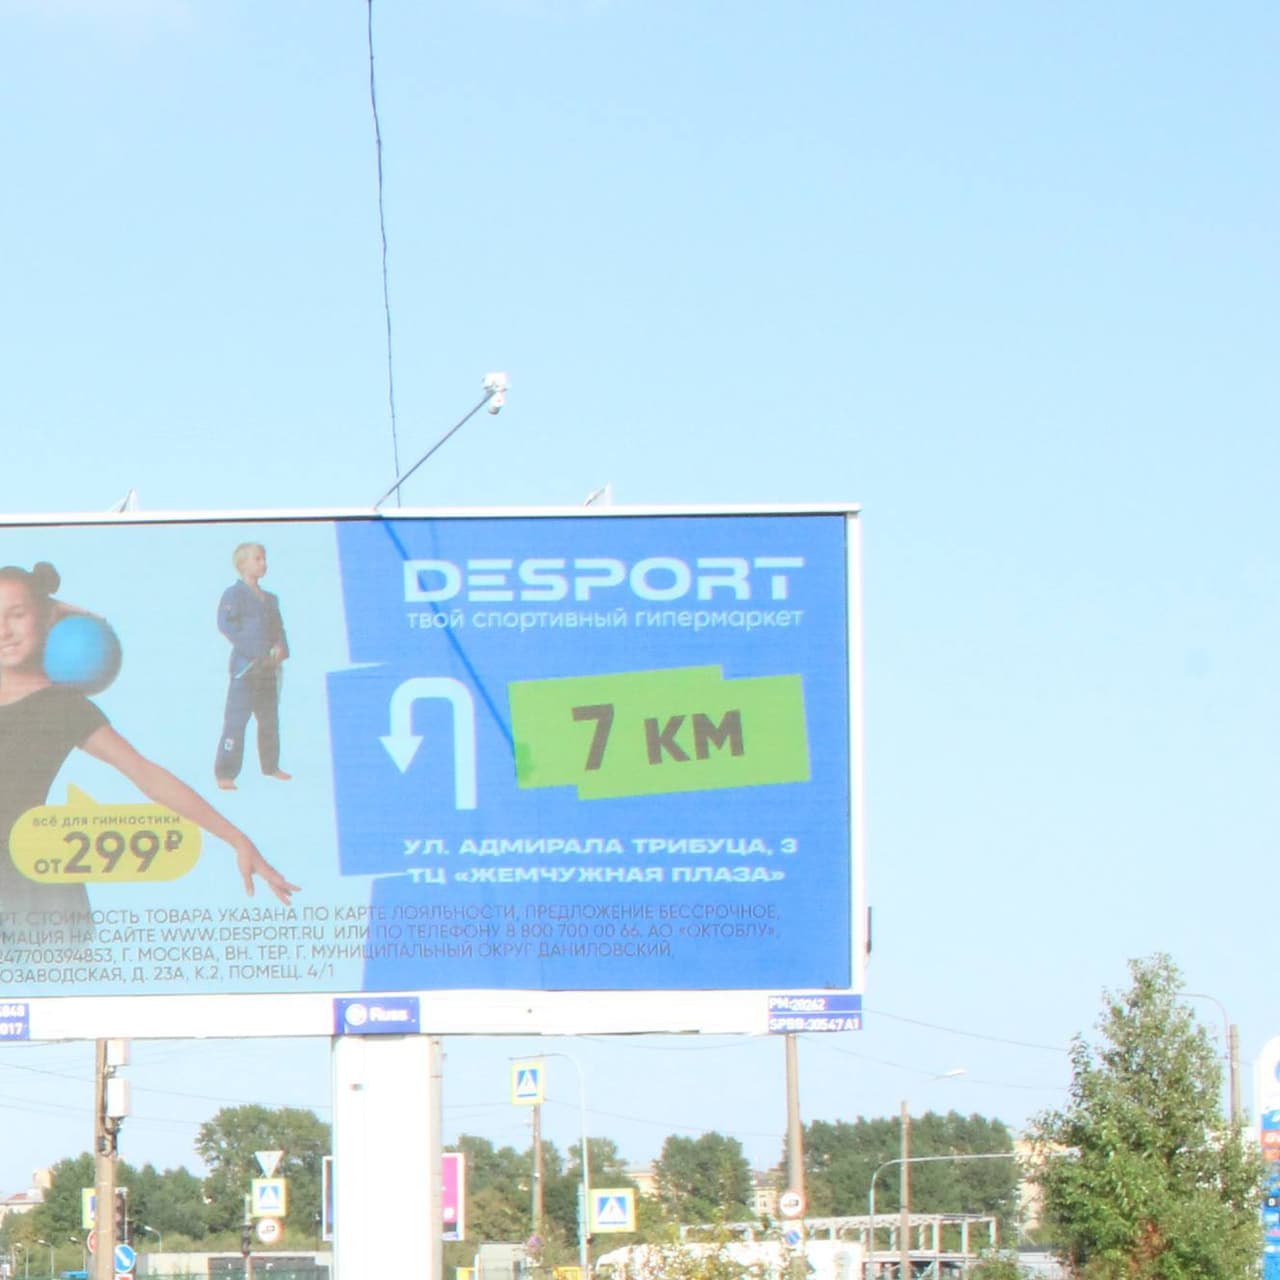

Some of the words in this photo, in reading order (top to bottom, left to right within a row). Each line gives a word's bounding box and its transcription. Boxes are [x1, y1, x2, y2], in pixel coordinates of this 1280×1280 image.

[403, 557, 805, 602] DESPORT
[408, 609, 464, 629] твой
[472, 609, 627, 632] спортивный
[635, 608, 804, 632] гипермаркет
[571, 703, 614, 772] 7
[62, 816, 88, 828] для
[403, 840, 449, 857] УЛ.
[459, 839, 623, 858] АДМИРАЛА
[632, 838, 773, 858] ТРИБУЦА,
[780, 838, 798, 855] 3
[407, 867, 446, 885] ТЦ
[455, 866, 662, 884] «ЖЕМЧУЖНАЯ
[672, 866, 785, 883] ПЛАЗА»
[26, 910, 139, 927] СТОИМОСТЬ
[145, 909, 212, 924] ТОВАРА
[218, 907, 297, 922] УКАЗАНА
[303, 907, 328, 921] ПО
[335, 906, 386, 921] КАРТЕ
[71, 929, 96, 943] НА
[99, 926, 156, 943] САЙТЕ
[161, 926, 324, 943] WWW.DESPORT.RU
[334, 925, 369, 940] ИЛИ
[377, 925, 401, 939] ПО
[408, 924, 501, 939] ТЕЛЕФОНУ
[506, 925, 516, 937] 8
[521, 924, 553, 938] 800
[559, 924, 589, 938] 700
[648, 923, 673, 937] АО
[138, 947, 219, 963] МОСКВА,
[225, 947, 252, 961] ВН.
[312, 942, 473, 960] МУНИЦИПАЛЬНЫЙ
[479, 942, 530, 957] ОКРУГ
[131, 967, 148, 983] Д.
[229, 964, 302, 981] ПОМЕЩ.
[307, 963, 335, 979] 4/1
